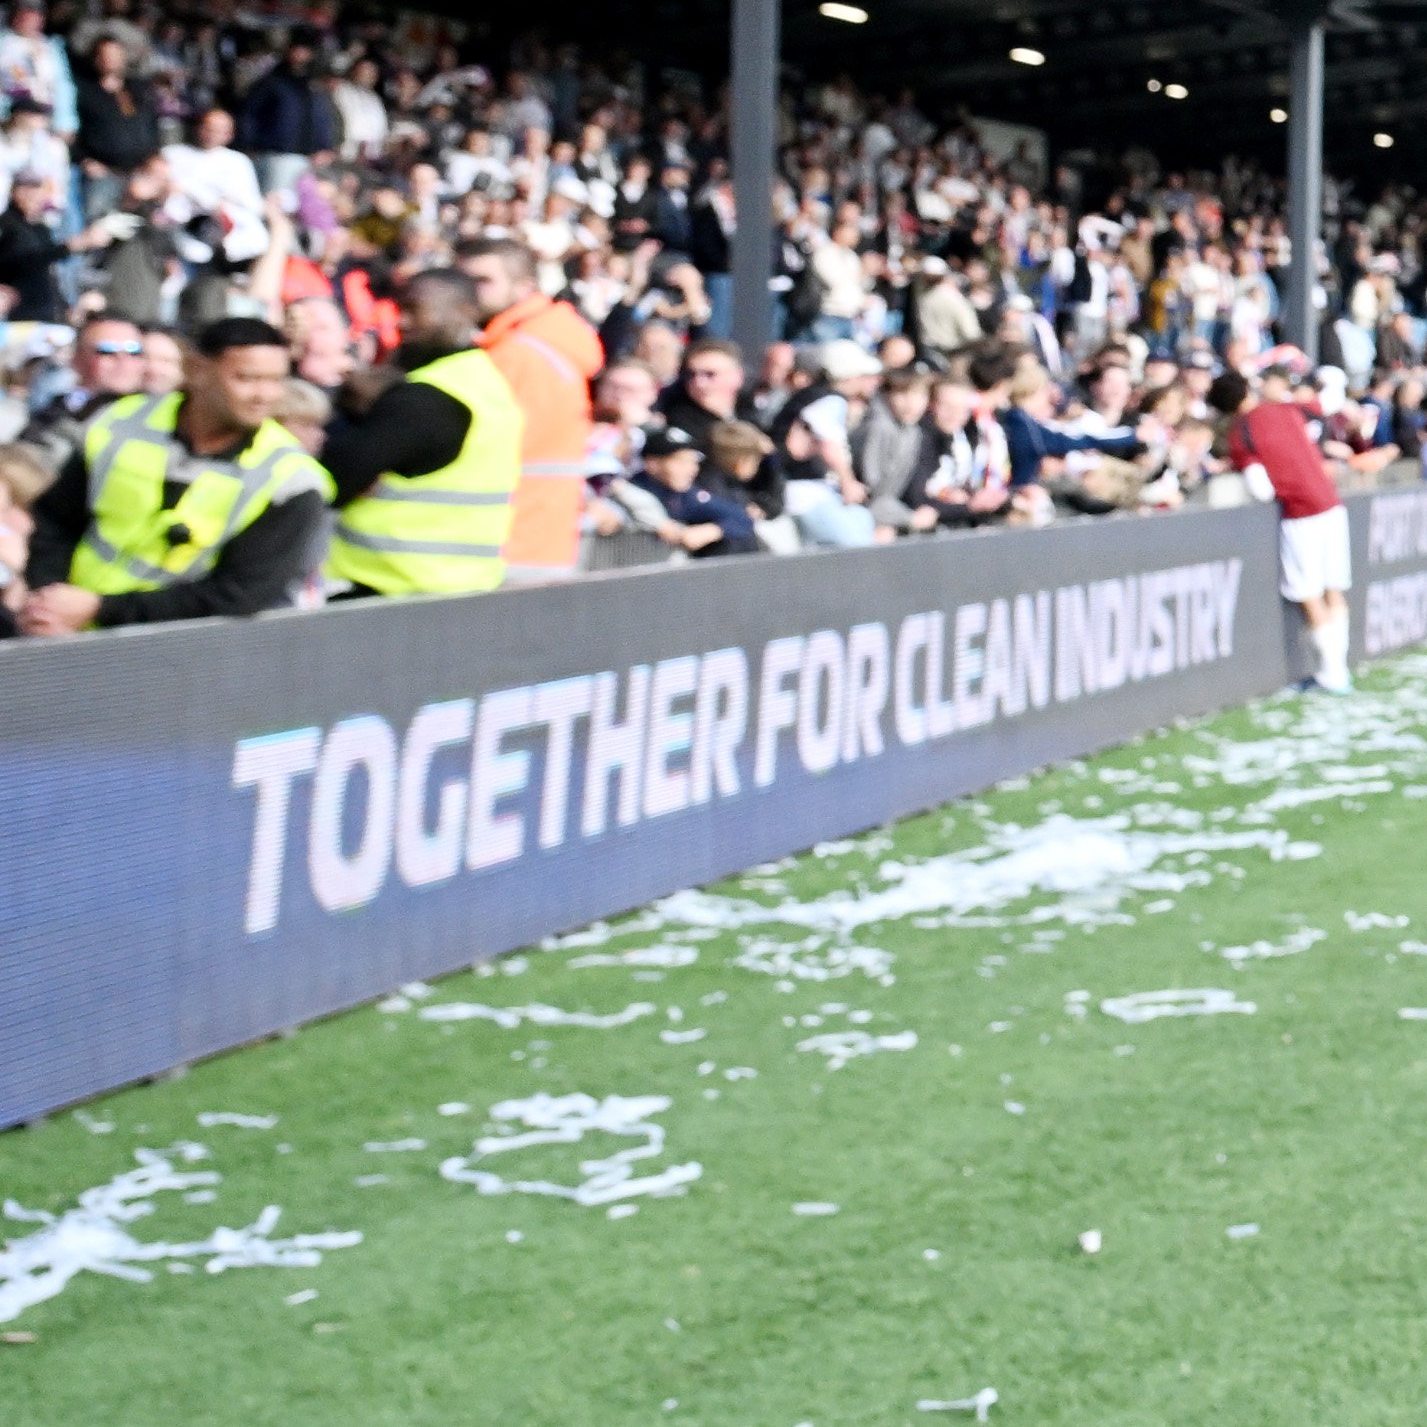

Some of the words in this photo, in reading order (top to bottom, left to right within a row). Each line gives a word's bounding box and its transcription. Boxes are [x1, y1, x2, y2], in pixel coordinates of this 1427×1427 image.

[232, 645, 749, 935] TOGETHER
[754, 621, 891, 788] FOR
[895, 590, 1052, 747] CLEAN
[1053, 557, 1243, 704] INDUSTRY
